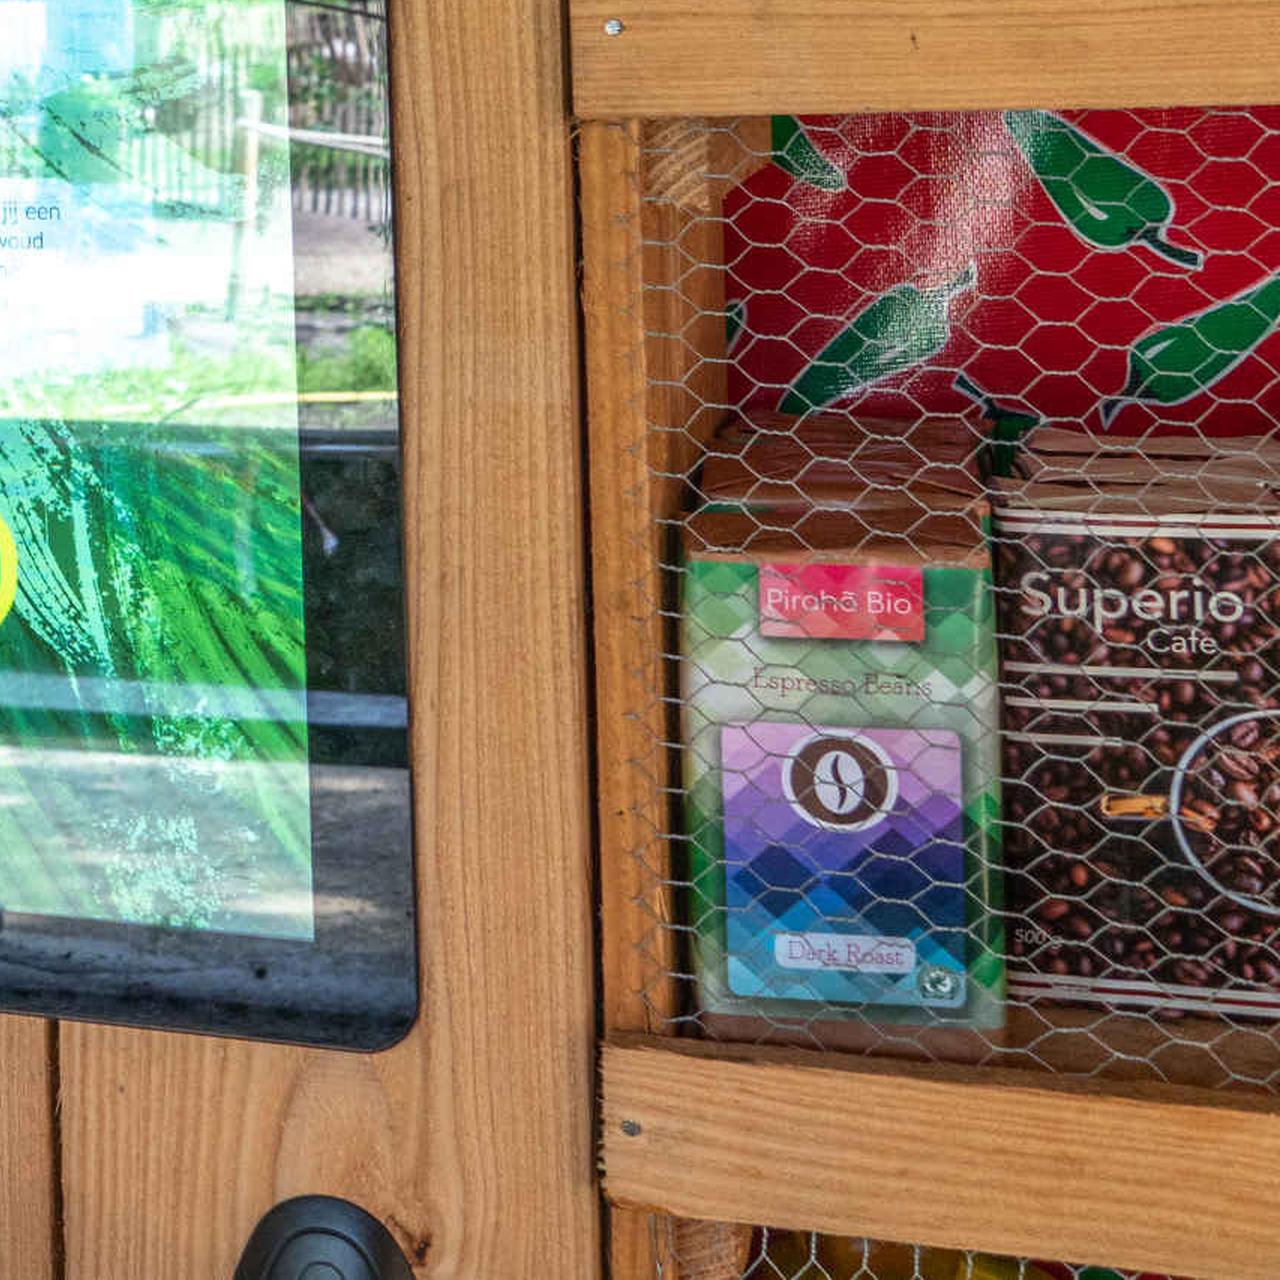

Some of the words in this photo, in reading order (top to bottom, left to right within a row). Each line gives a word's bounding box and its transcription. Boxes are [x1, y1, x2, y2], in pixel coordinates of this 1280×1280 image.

[1, 201, 19, 226] jij
[24, 204, 61, 221] een
[866, 590, 913, 615] Bio
[1020, 571, 1245, 634] Superio
[752, 666, 857, 698] Espresso
[862, 672, 934, 697] Beans
[787, 939, 840, 965] Dark
[846, 942, 905, 967] Roast
